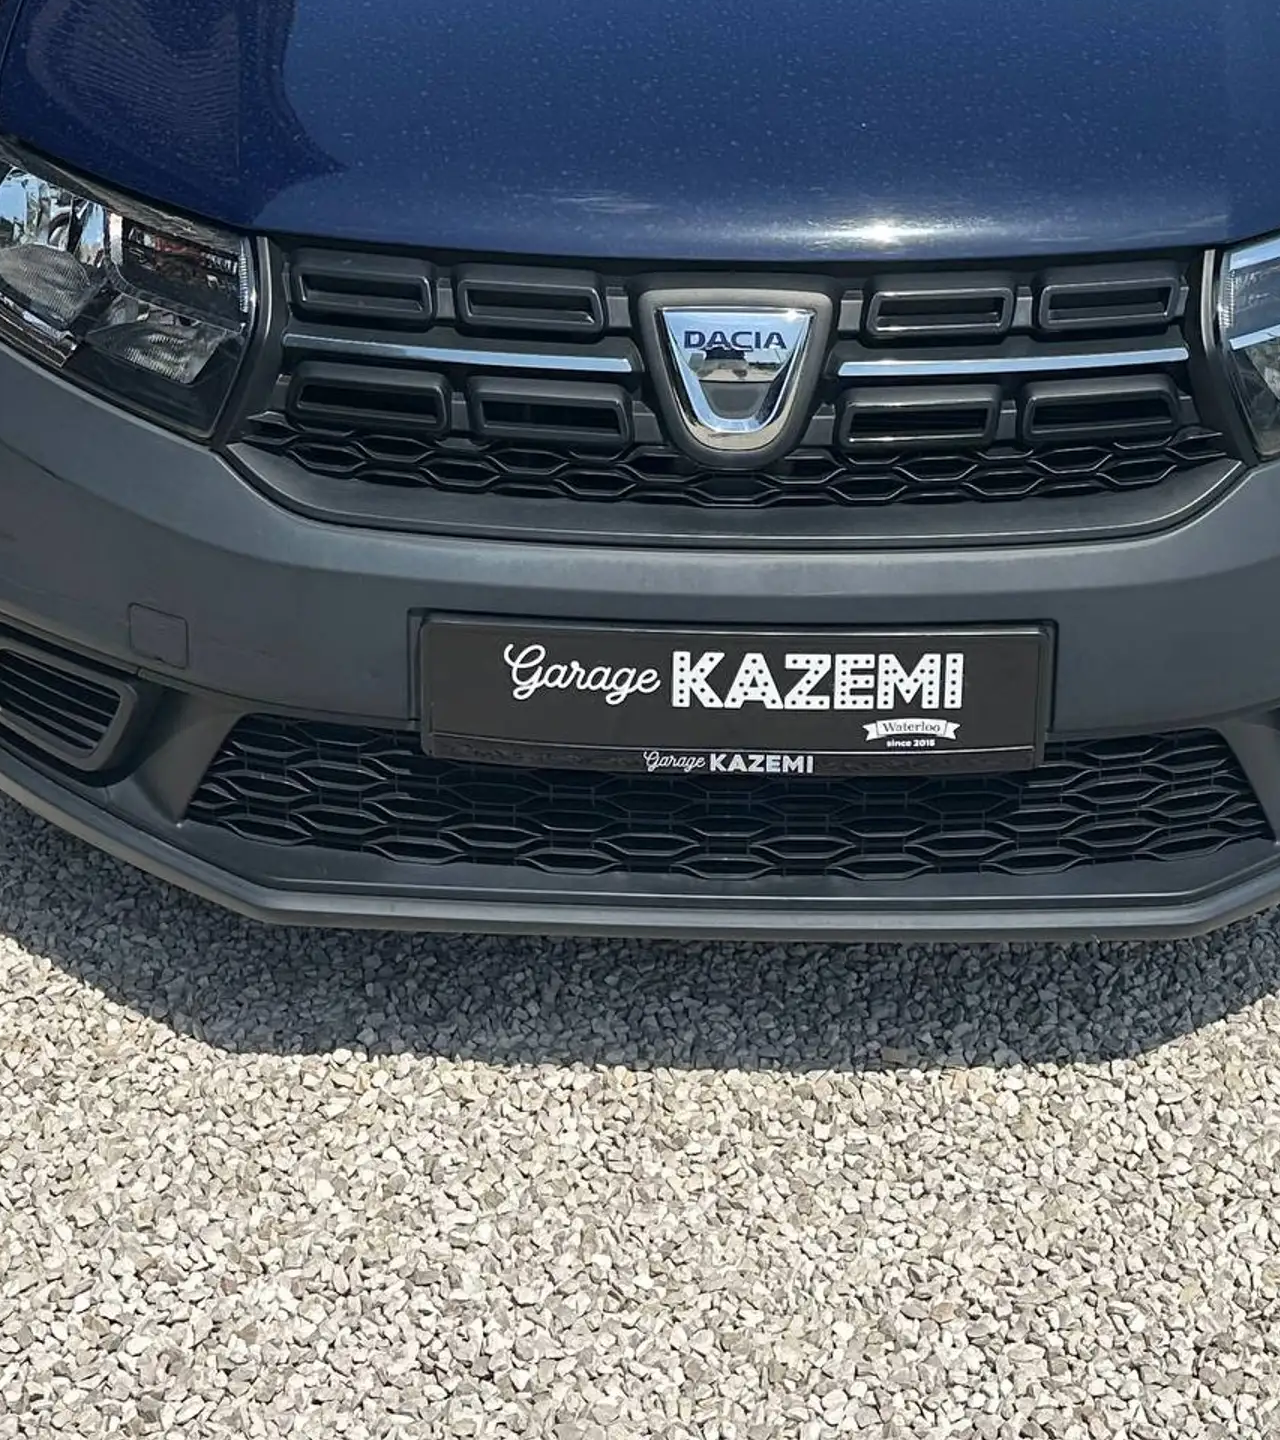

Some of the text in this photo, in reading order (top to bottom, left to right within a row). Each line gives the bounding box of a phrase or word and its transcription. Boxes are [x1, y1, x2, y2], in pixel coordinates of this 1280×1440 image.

[684, 330, 787, 351] DACIA
[504, 644, 964, 710] Garage KAZEMI
[883, 721, 940, 732] Waterloo
[886, 738, 912, 748] since
[643, 750, 814, 773] Garage KAZEMI
